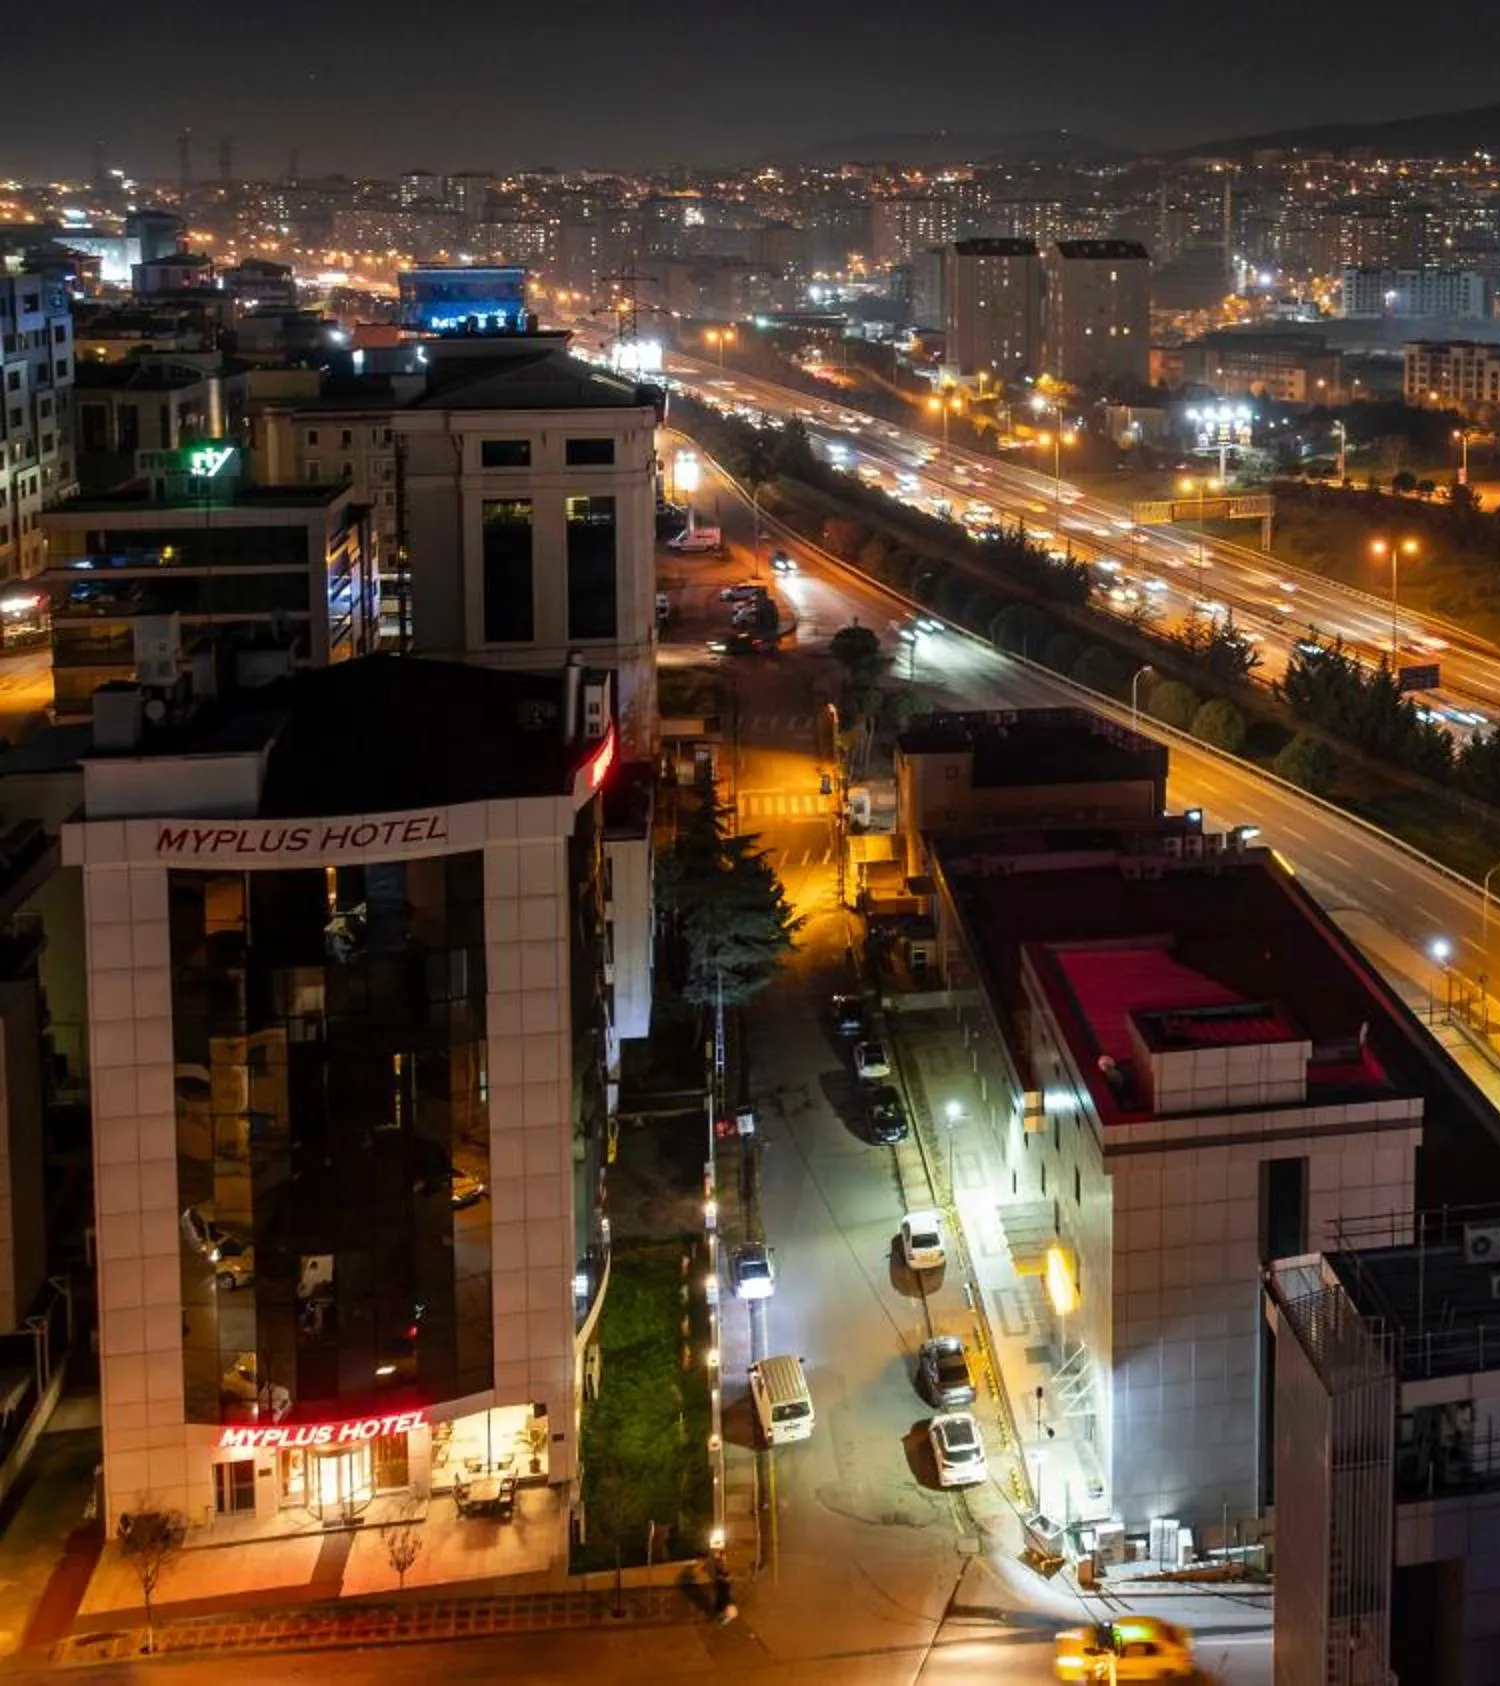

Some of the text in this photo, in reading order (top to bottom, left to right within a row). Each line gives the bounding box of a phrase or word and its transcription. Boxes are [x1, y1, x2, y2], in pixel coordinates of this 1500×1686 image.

[157, 816, 447, 853] MYPLUS HOTEL
[220, 1411, 429, 1448] MYPLUS HOTEL
